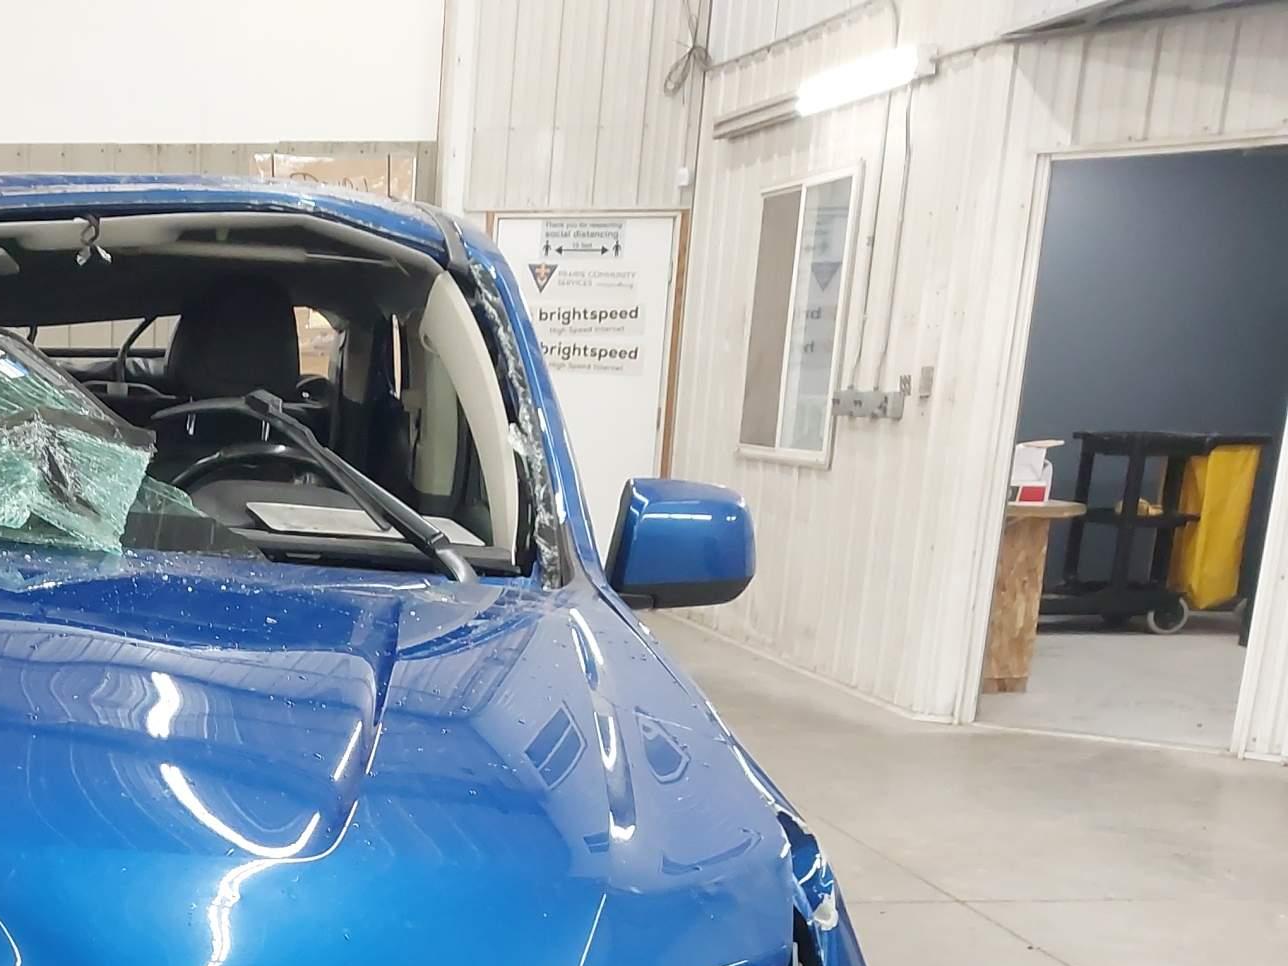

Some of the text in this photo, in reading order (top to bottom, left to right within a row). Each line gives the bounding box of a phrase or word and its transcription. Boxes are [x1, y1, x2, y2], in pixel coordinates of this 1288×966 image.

[545, 230, 619, 240] social distancing
[539, 305, 639, 325] brightspeed
[540, 341, 639, 361] brightspeed
